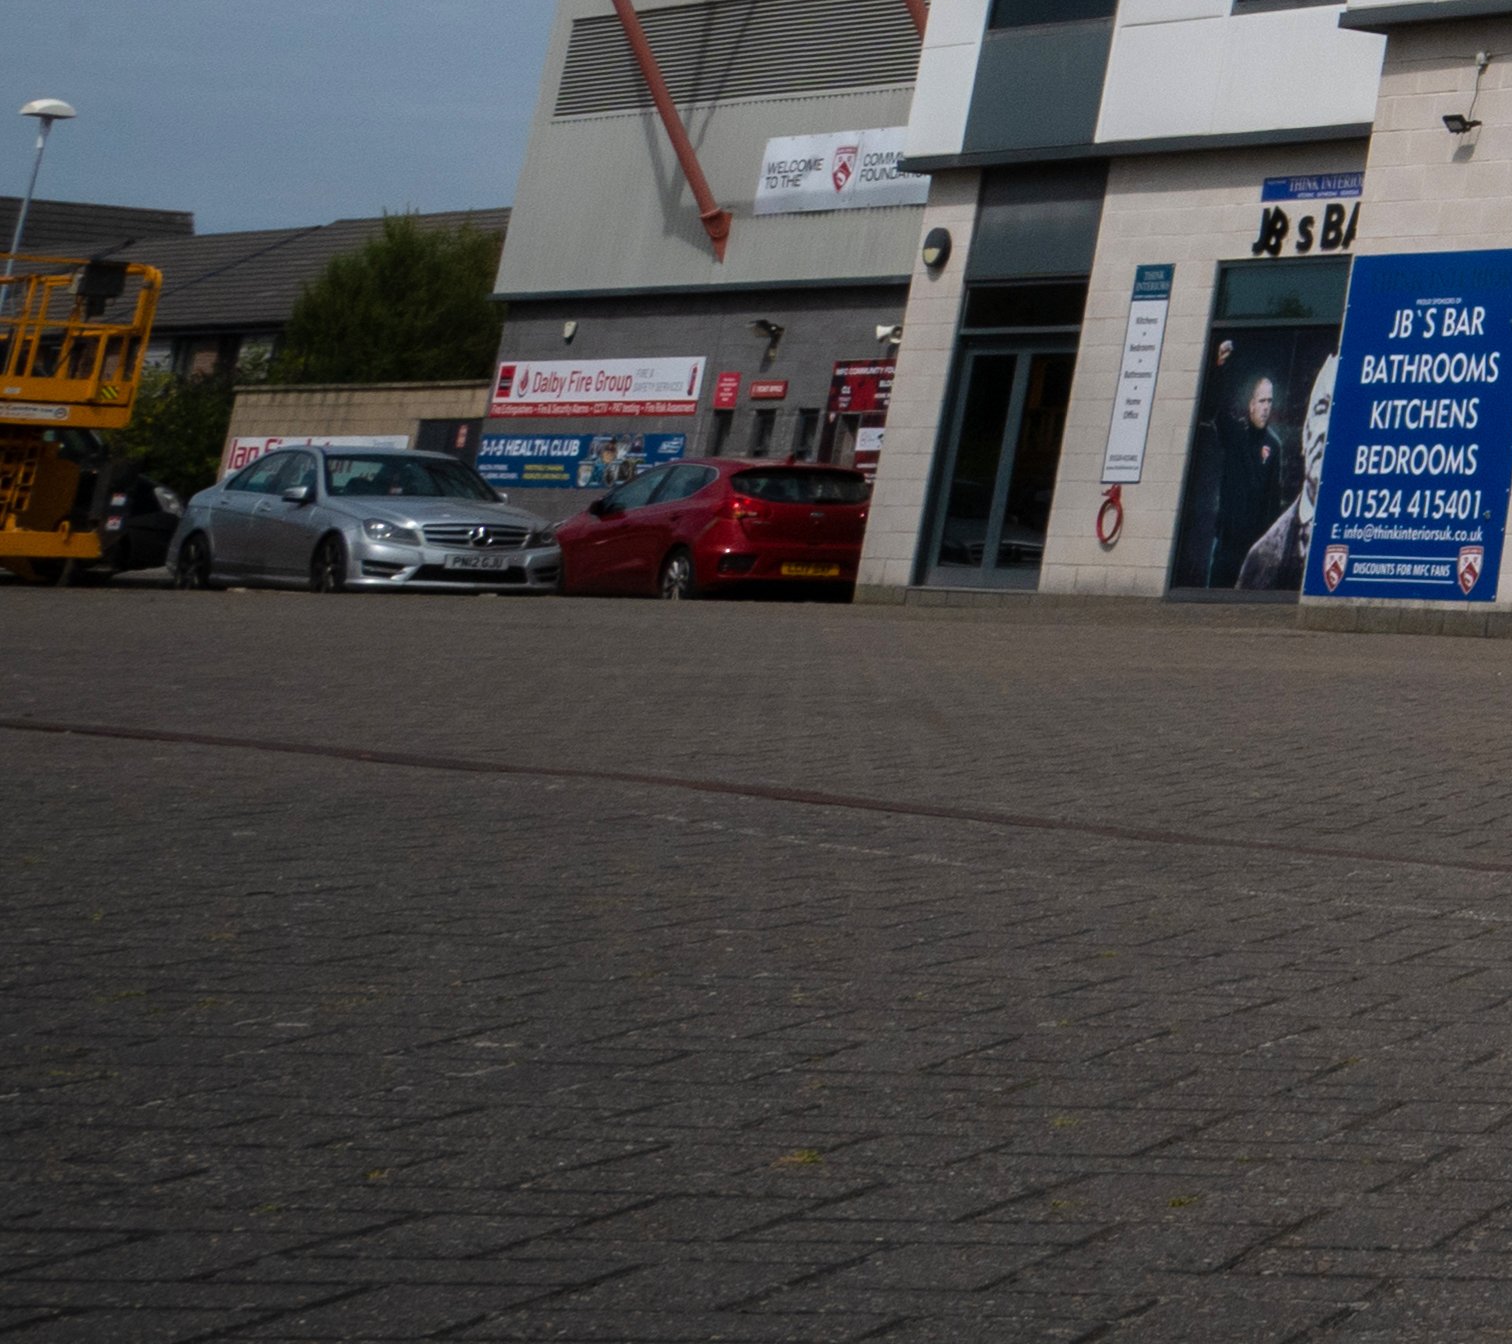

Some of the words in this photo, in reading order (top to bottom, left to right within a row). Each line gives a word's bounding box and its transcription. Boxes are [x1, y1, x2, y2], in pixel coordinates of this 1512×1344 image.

[767, 158, 824, 174] WELCOME
[765, 176, 779, 189] TO
[781, 174, 802, 188] THE
[1442, 306, 1485, 337] BAR
[1360, 352, 1500, 384] BATHROOMS
[532, 371, 566, 397] Dalby
[568, 370, 593, 393] Fire
[595, 370, 633, 396] Group
[1369, 398, 1480, 429] KITCHENS
[228, 439, 260, 470] Ian
[505, 439, 549, 456] HEALTH
[550, 440, 580, 456] CLUB
[1354, 444, 1479, 475] BEDROOMS
[1341, 489, 1401, 519] 01524
[1407, 490, 1481, 520] 415401
[1331, 523, 1341, 539] E:
[1343, 523, 1483, 542] info@thinkinteriorsuk.co.uk
[1353, 562, 1395, 576] DISCOUNTS
[1396, 563, 1411, 576] FOR
[1413, 563, 1430, 576] MFC
[1431, 564, 1450, 577] FANS
